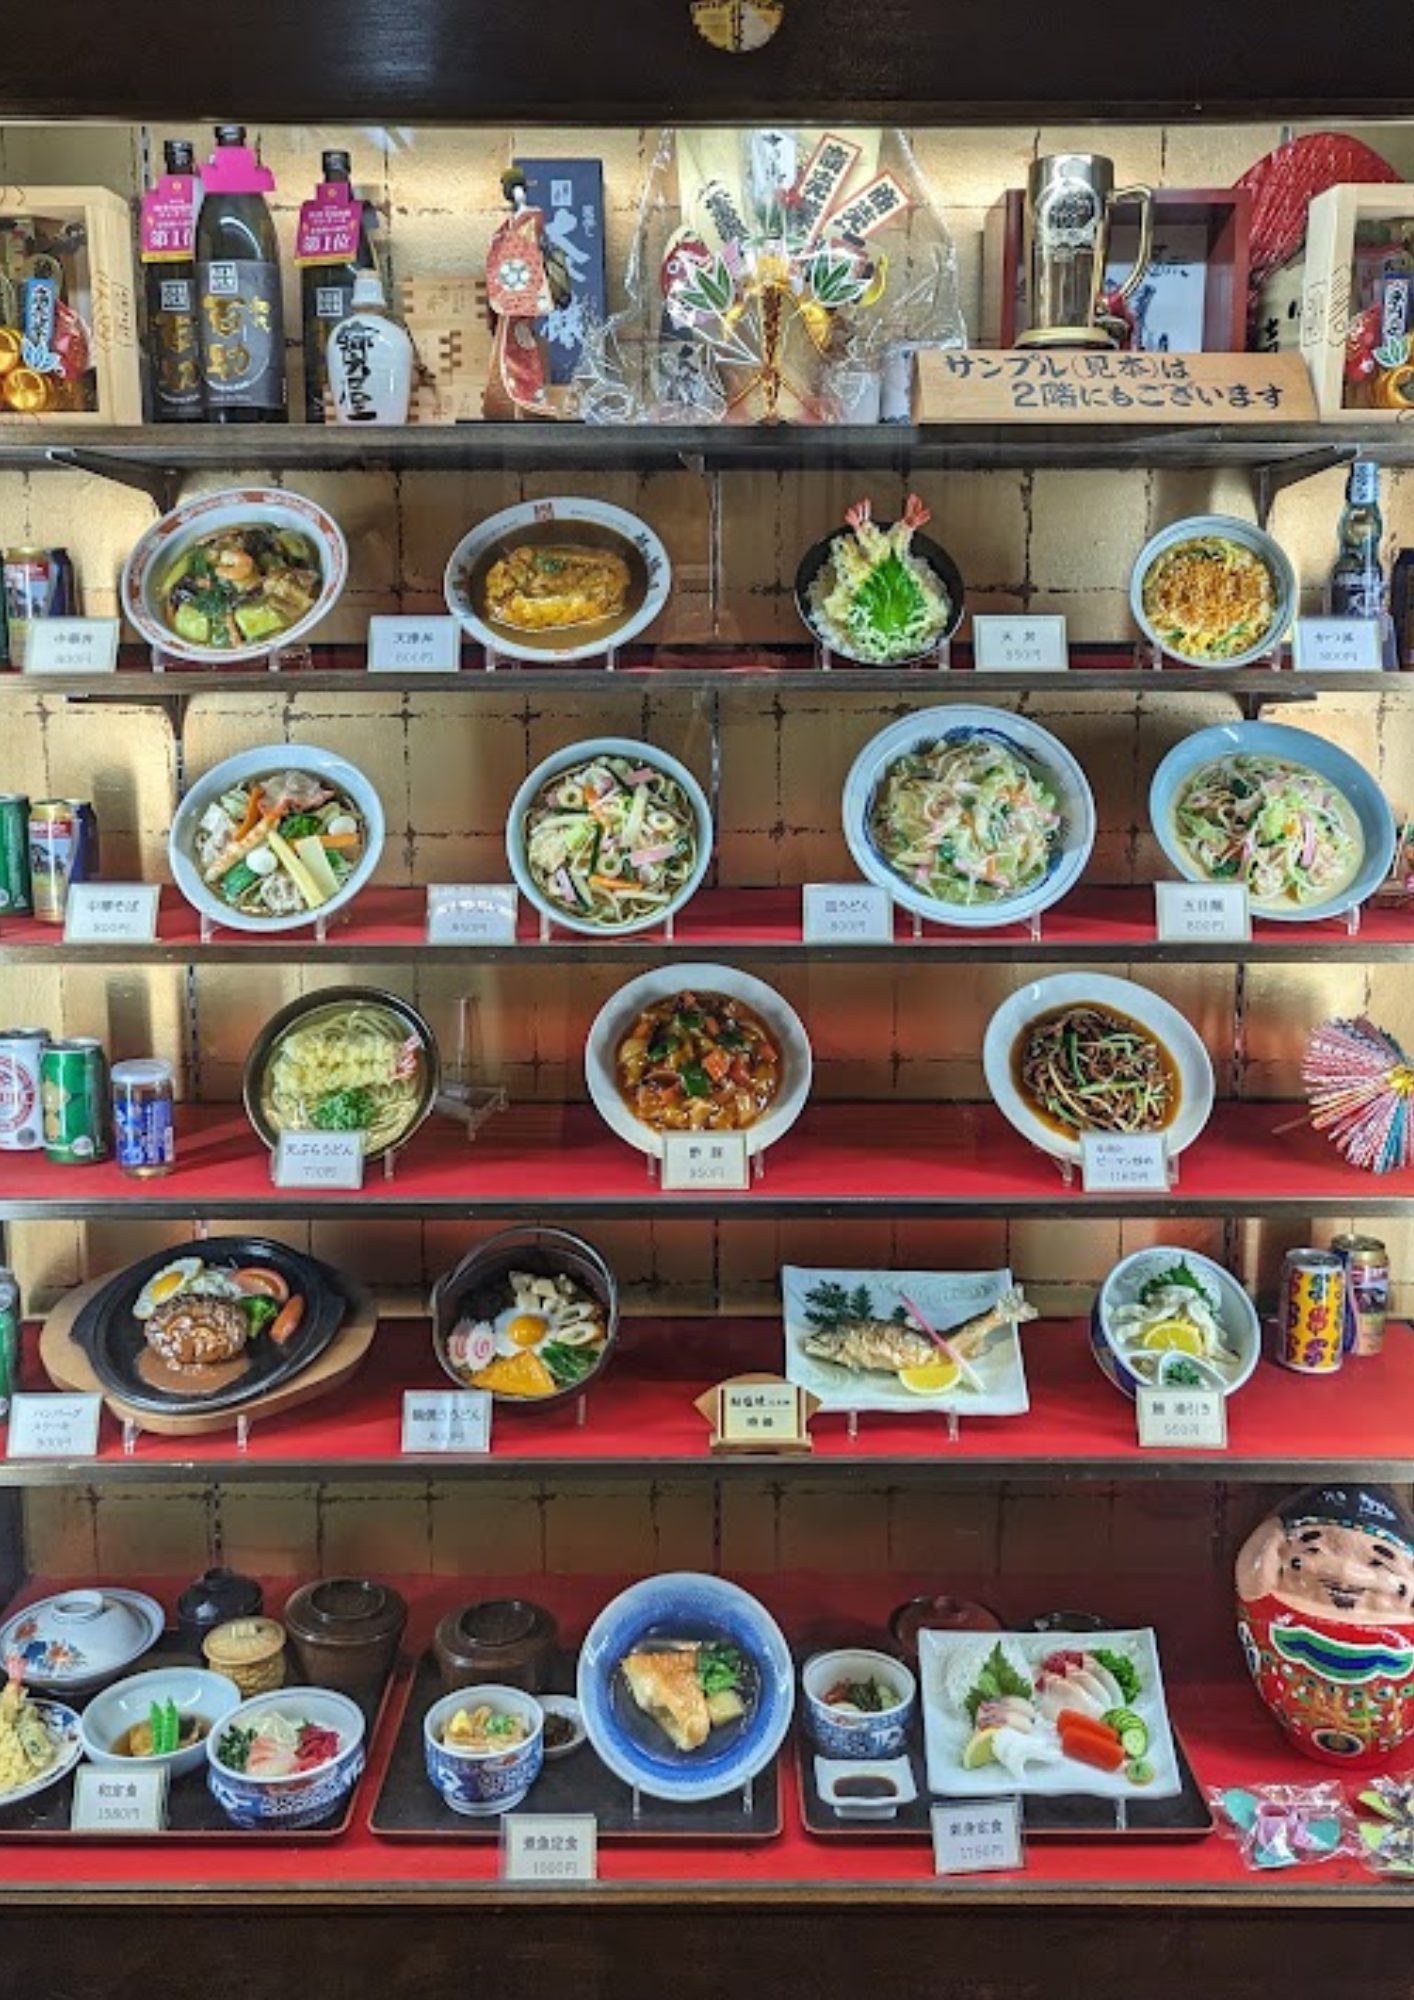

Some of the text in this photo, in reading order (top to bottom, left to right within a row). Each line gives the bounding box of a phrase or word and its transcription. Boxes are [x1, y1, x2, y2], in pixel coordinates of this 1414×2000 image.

[1011, 381, 1285, 409] 2階にもございます
[285, 1143, 354, 1156] 天ぷらうどん
